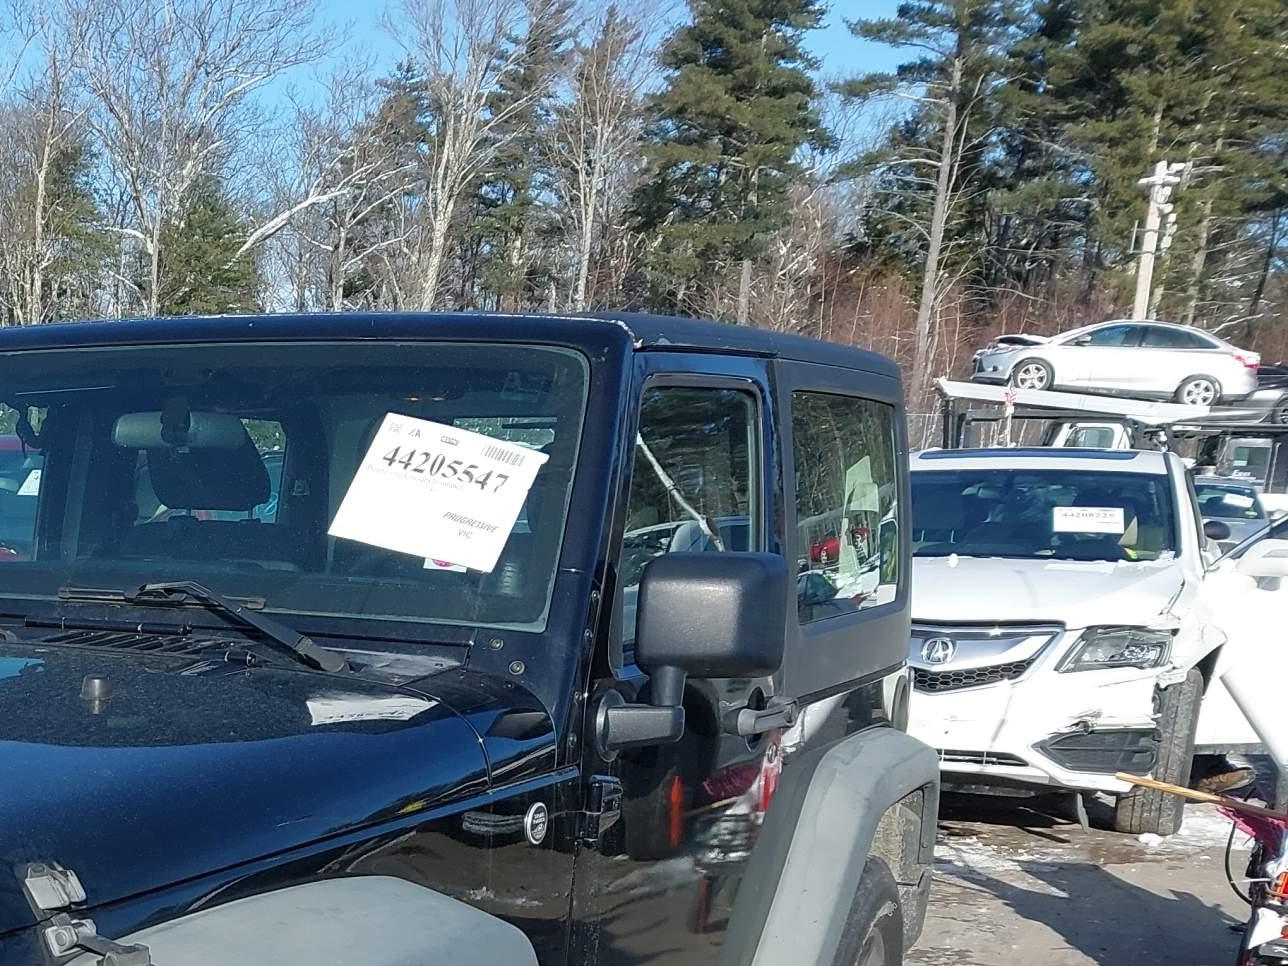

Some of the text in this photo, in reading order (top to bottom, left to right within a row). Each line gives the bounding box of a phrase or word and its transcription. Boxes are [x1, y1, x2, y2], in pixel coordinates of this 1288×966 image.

[382, 446, 509, 493] 44205547
[442, 511, 500, 534] PROGRESSIVE
[457, 528, 473, 539] VIC
